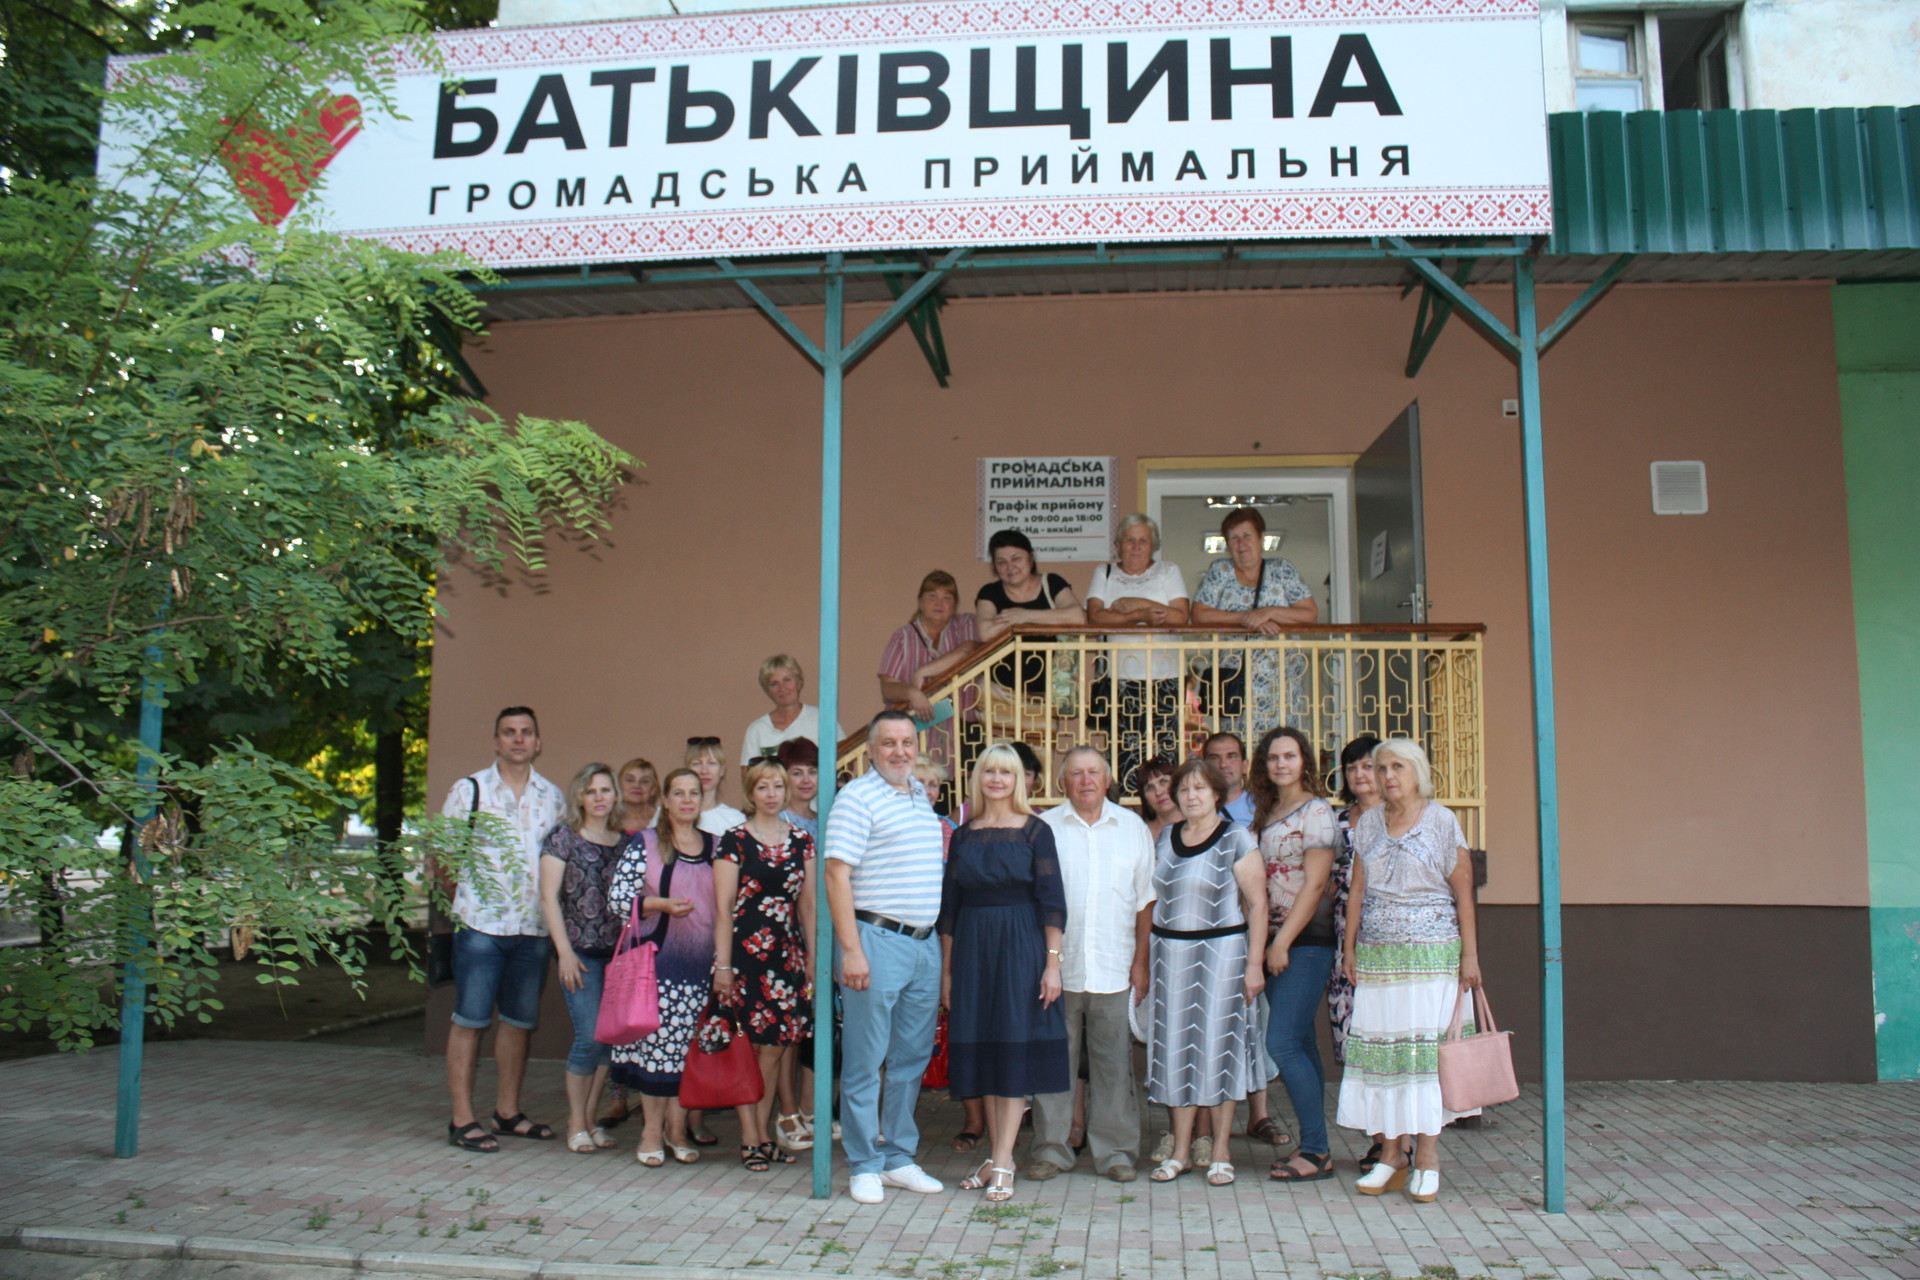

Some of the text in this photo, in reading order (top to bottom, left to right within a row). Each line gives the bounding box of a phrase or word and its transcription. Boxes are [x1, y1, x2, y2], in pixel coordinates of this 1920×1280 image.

[433, 33, 1404, 159] БАТЬКІВЩИНА
[429, 145, 1411, 215] ГРОМАДСЬКА ПРИЙМАЛЬНЯ
[992, 461, 1104, 474] ГРОМАДСЬКА
[990, 474, 1105, 488] ПРИЙМАЛЬНЯ
[989, 499, 1104, 512] Графік прийому
[1031, 515, 1060, 523] 09:00
[1076, 514, 1103, 522] 18:00
